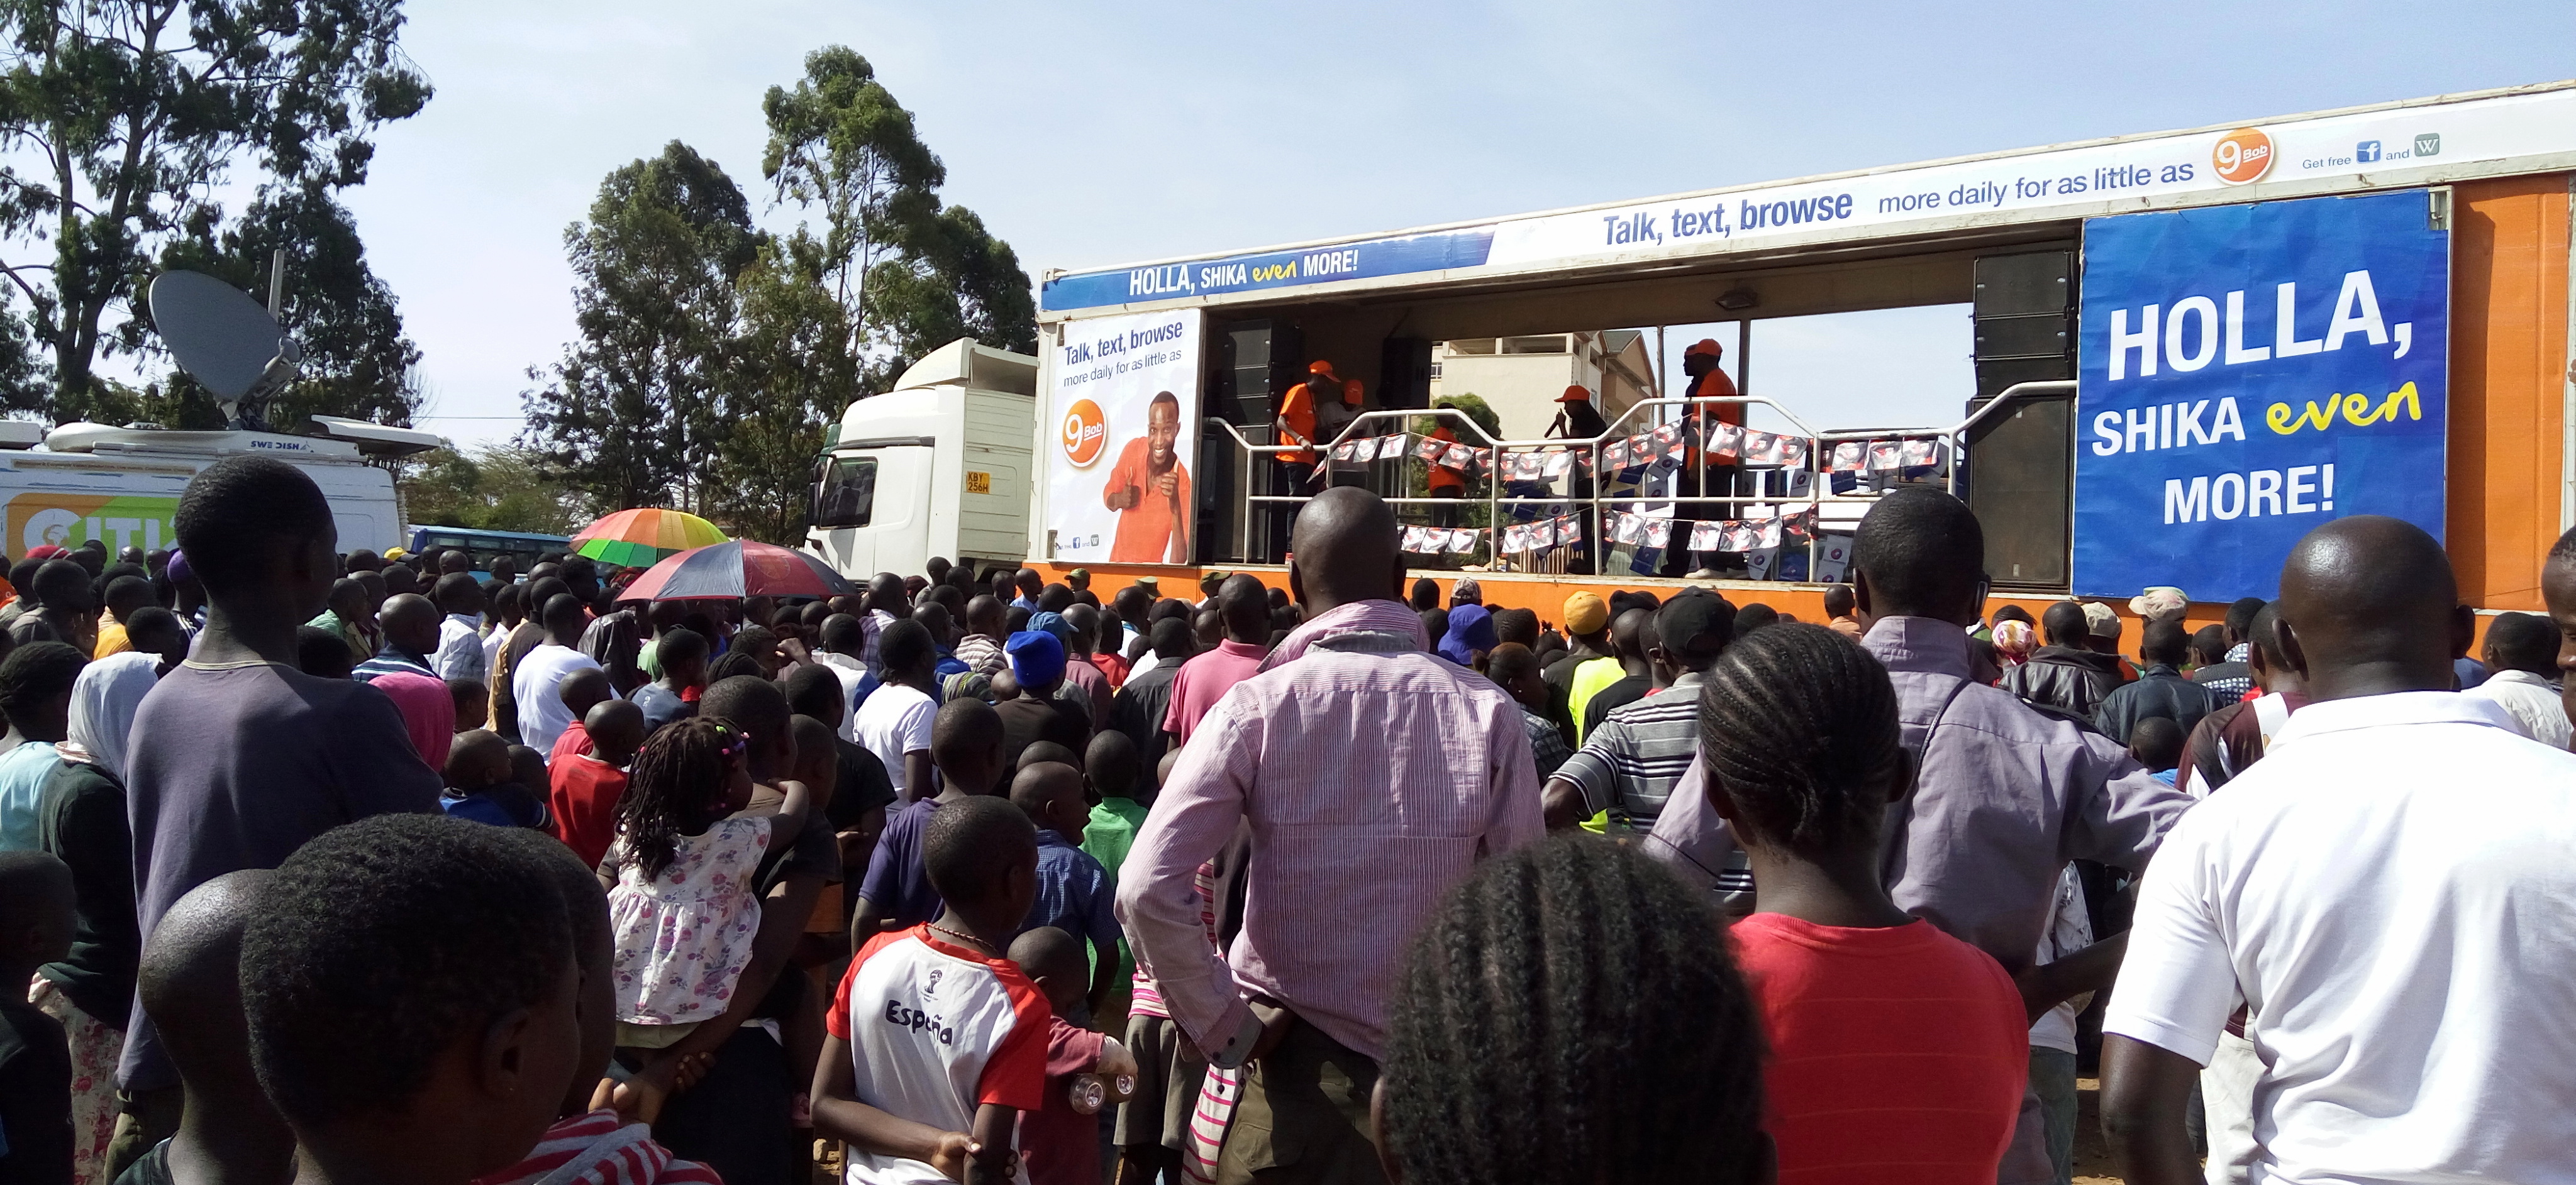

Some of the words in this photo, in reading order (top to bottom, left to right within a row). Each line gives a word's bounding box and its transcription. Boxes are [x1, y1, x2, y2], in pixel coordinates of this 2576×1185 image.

[2216, 140, 2241, 175] 9
[2243, 144, 2268, 159] Bob
[2302, 159, 2324, 169] Get
[2328, 156, 2351, 167] free
[2385, 149, 2409, 161] and
[1603, 212, 1663, 246] Talk,
[1671, 202, 1731, 238] text,
[1740, 193, 1853, 230] browse
[1879, 192, 1940, 214] more
[1948, 180, 2007, 207] daily
[2015, 177, 2052, 199] for
[2057, 175, 2087, 194] as
[2094, 163, 2151, 190] little
[2160, 162, 2194, 182] as
[1129, 264, 1195, 295] HOLLA,
[1201, 263, 1247, 288] SHIKA
[1252, 260, 1297, 282] even
[1303, 249, 1359, 277] MORE!
[1065, 342, 1094, 366] Talk,
[1097, 333, 1126, 358] text,
[1130, 321, 1183, 350] browse
[2109, 270, 2412, 382] HOLLA,
[1063, 372, 1088, 387] more
[1091, 365, 1113, 380] daily
[1116, 361, 1130, 375] for
[1131, 358, 1143, 370] as
[1145, 351, 1167, 368] little
[1169, 350, 1182, 361] as
[1065, 414, 1084, 453] 9
[1084, 421, 1102, 438] Bob
[2092, 396, 2246, 456] SHIKA
[2266, 380, 2423, 436] even
[968, 471, 984, 482] KBY
[968, 482, 988, 493] 256H
[2164, 463, 2334, 524] MORE!
[886, 1000, 953, 1047] España
